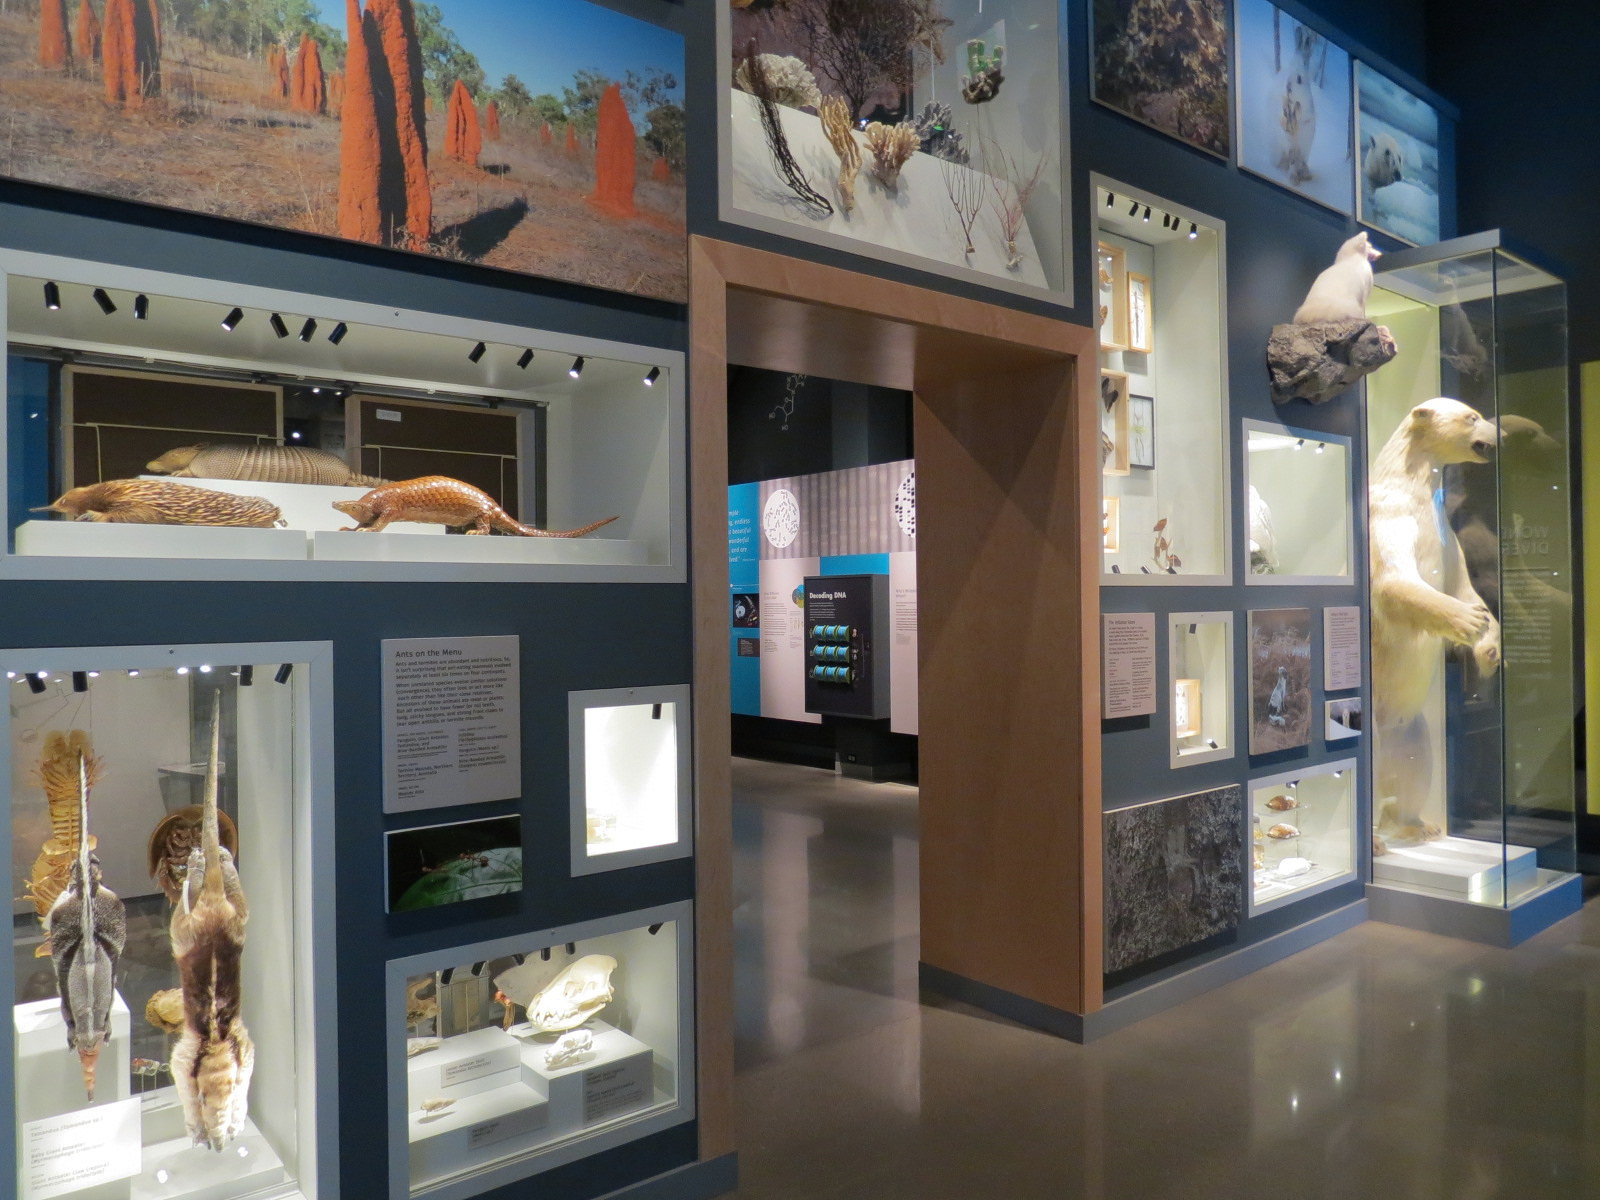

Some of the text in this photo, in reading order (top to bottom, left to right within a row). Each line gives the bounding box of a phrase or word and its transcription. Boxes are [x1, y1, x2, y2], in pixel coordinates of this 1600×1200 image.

[809, 591, 847, 601] Decoding DNA
[428, 649, 440, 657] the
[443, 648, 463, 656] Menu
